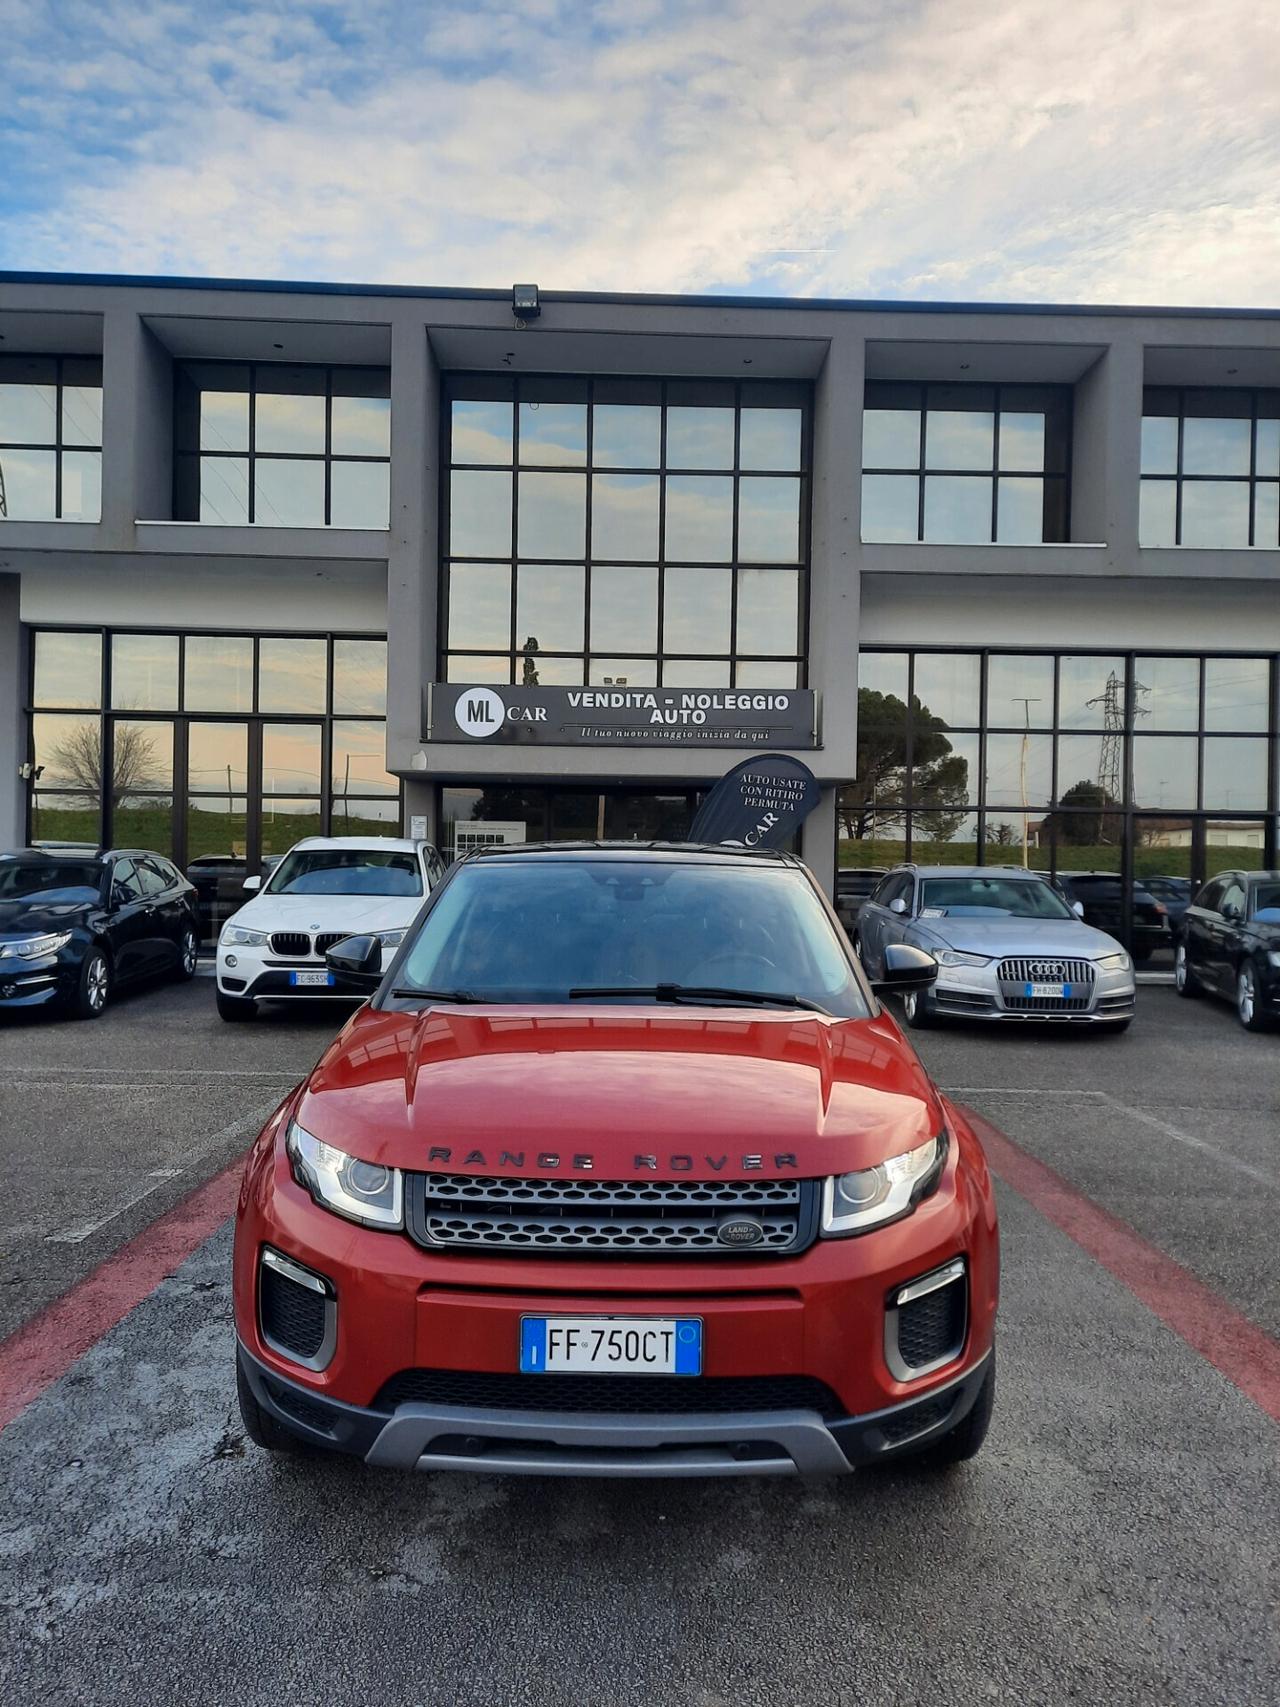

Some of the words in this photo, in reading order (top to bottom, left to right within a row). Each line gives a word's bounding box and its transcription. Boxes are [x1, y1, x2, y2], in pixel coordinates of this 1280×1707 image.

[568, 692, 658, 709] VENDITA
[682, 694, 789, 711] NOLEGGIO
[467, 699, 495, 723] ML
[506, 706, 548, 722] CAR
[650, 709, 707, 725] AUTO
[581, 727, 591, 737] Il
[594, 729, 612, 738] tuo
[616, 730, 649, 738] nuovo
[653, 728, 693, 741] viaggio
[697, 729, 731, 740] inizia
[734, 730, 747, 740] da
[751, 731, 770, 743] qui
[740, 773, 770, 785] AUTO
[773, 777, 806, 790] USATE
[740, 785, 763, 796] CON
[765, 787, 803, 801] RITIRO
[744, 797, 795, 811] PERMUTA
[744, 812, 780, 846] CAR
[428, 1146, 595, 1169] RANGE
[633, 1153, 799, 1171] ROVER
[729, 1233, 755, 1241] ROVER
